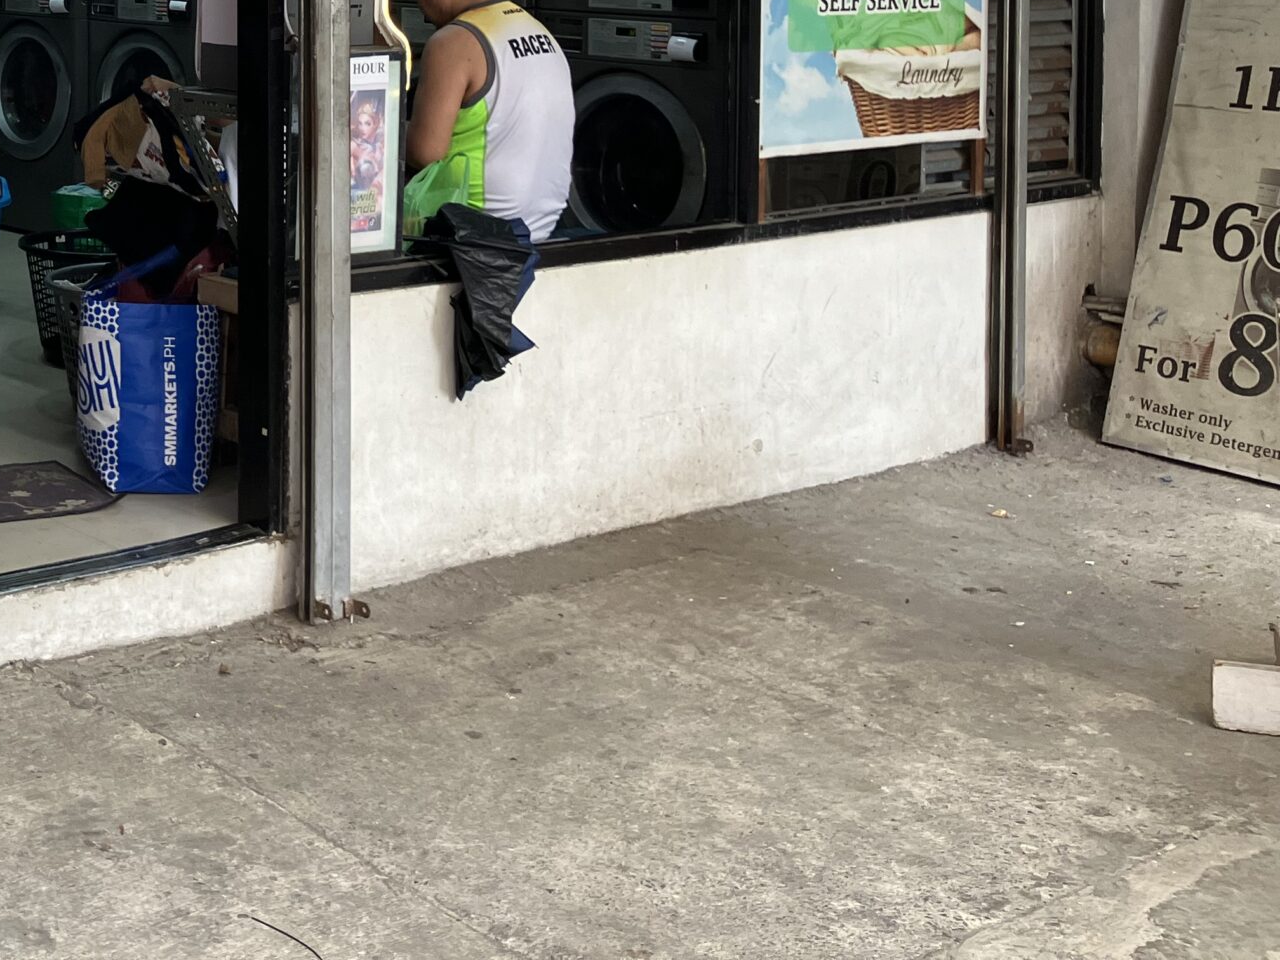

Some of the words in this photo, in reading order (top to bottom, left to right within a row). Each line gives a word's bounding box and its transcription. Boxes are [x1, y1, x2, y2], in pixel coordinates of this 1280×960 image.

[508, 34, 557, 59] RACER
[353, 62, 385, 75] HOUR
[896, 58, 964, 88] Laundry
[350, 202, 377, 215] endo
[1134, 344, 1197, 384] For
[1139, 397, 1195, 422] Washer
[1198, 412, 1233, 432] only
[1134, 415, 1206, 443] Exclusive
